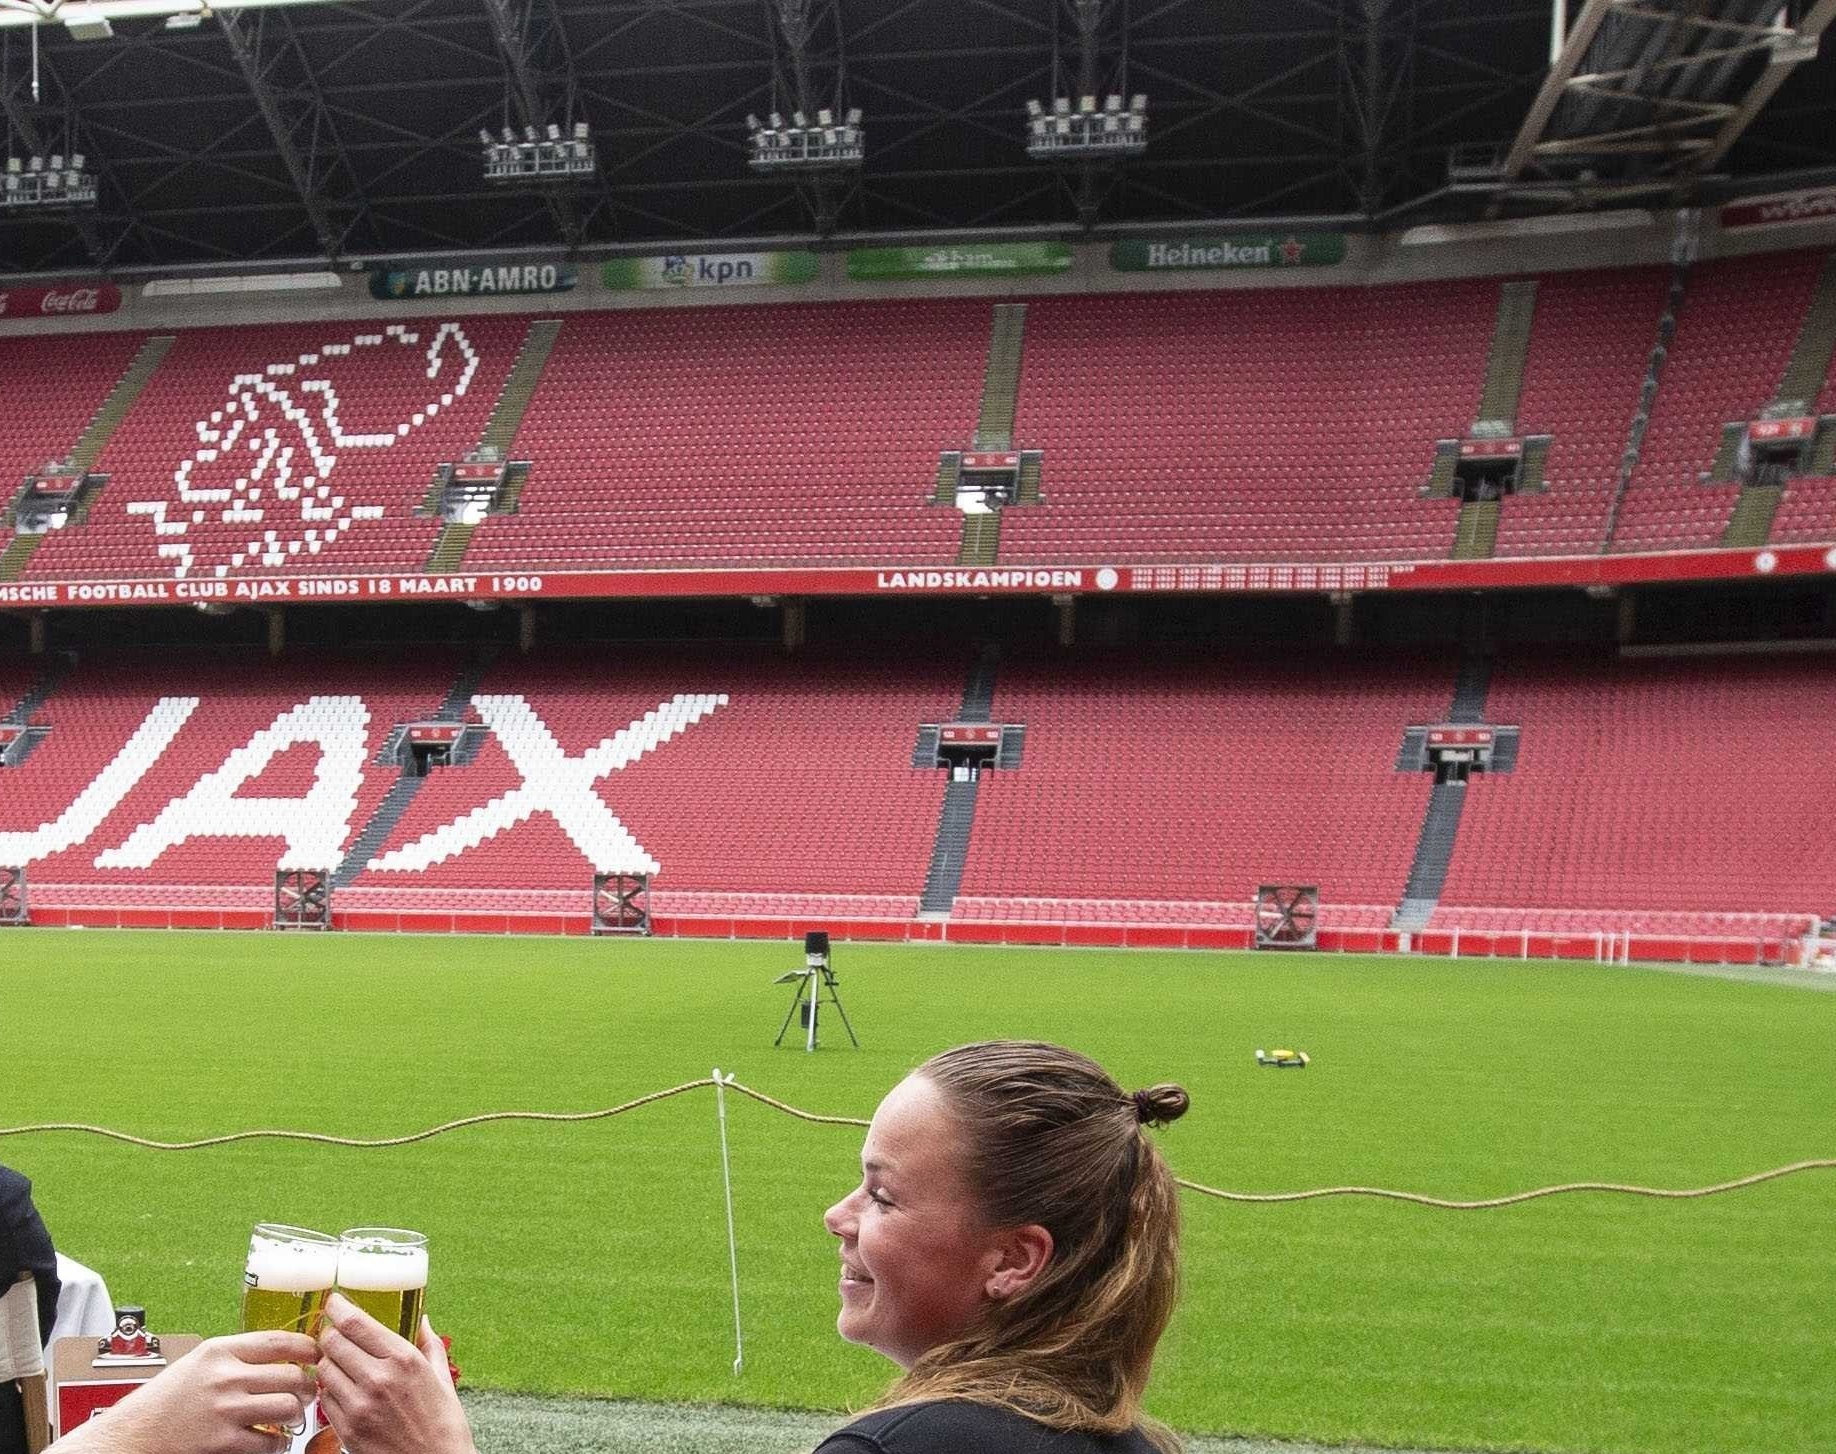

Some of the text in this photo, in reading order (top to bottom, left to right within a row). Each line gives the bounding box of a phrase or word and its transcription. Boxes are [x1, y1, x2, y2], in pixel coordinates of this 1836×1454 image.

[1147, 240, 1272, 266] Heineken
[699, 257, 753, 284] kpn
[67, 583, 169, 600] FOOTBALL
[175, 582, 228, 597] CLUB
[235, 580, 291, 599] AJAX
[298, 579, 360, 595] SINDS
[368, 578, 391, 594] 18
[399, 577, 477, 594] MAART
[491, 576, 542, 592] 1900
[877, 570, 1082, 588] LANDSKAMPIOEN
